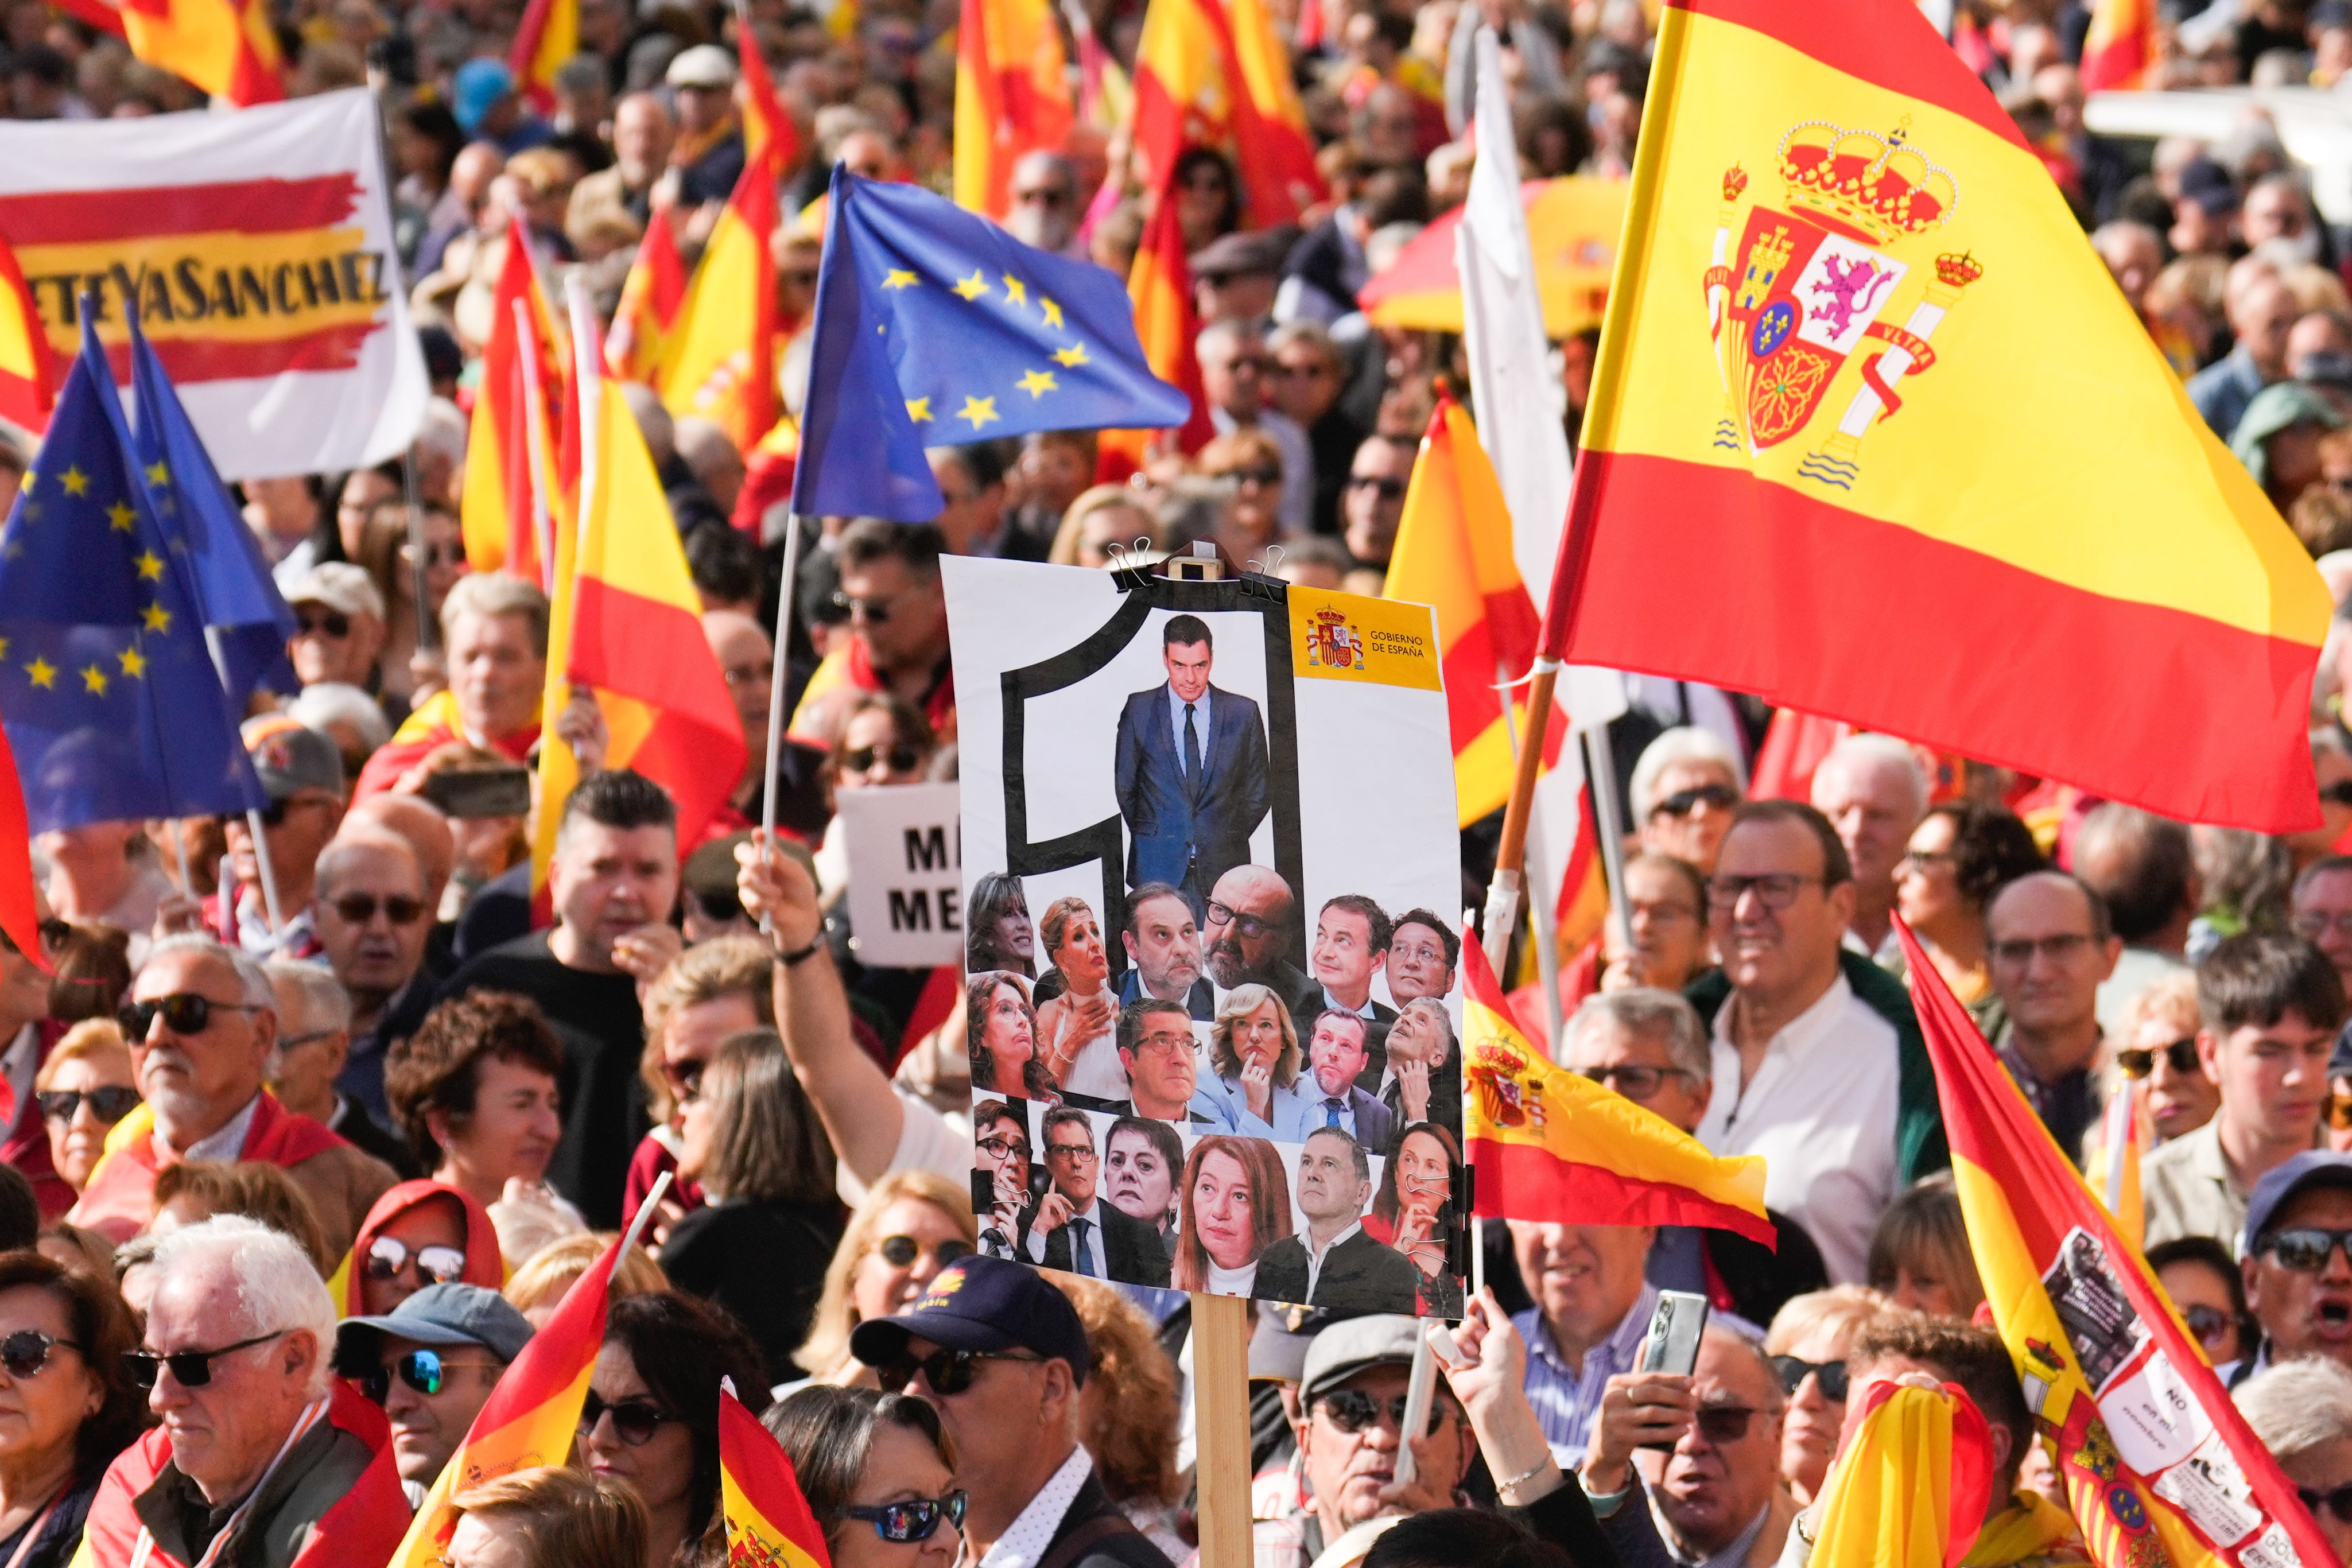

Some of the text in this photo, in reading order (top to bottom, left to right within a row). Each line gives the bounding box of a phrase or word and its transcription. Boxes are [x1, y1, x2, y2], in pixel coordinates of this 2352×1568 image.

[1883, 325, 1931, 365] VLTRA
[1371, 631, 1423, 646] GOBIERNO
[1372, 642, 1424, 658] DE ESPAÑA
[2166, 1388, 2186, 1410] NO
